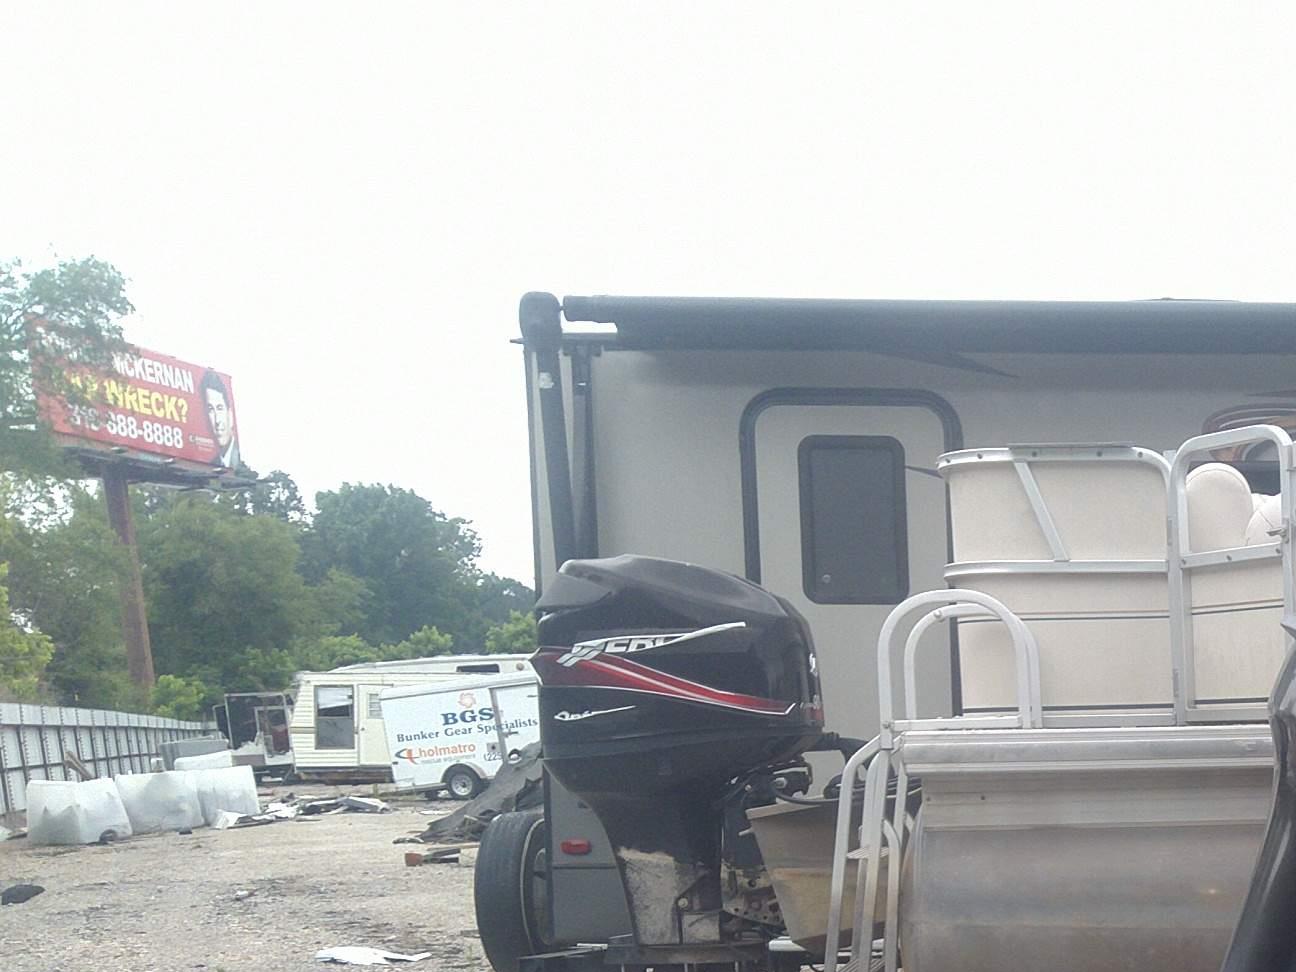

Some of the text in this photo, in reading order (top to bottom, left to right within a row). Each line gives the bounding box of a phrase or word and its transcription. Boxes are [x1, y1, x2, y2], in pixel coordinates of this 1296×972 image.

[440, 707, 495, 726] BGS
[396, 717, 539, 743] Bunker Gear Specialists
[418, 743, 476, 758] holmatro
